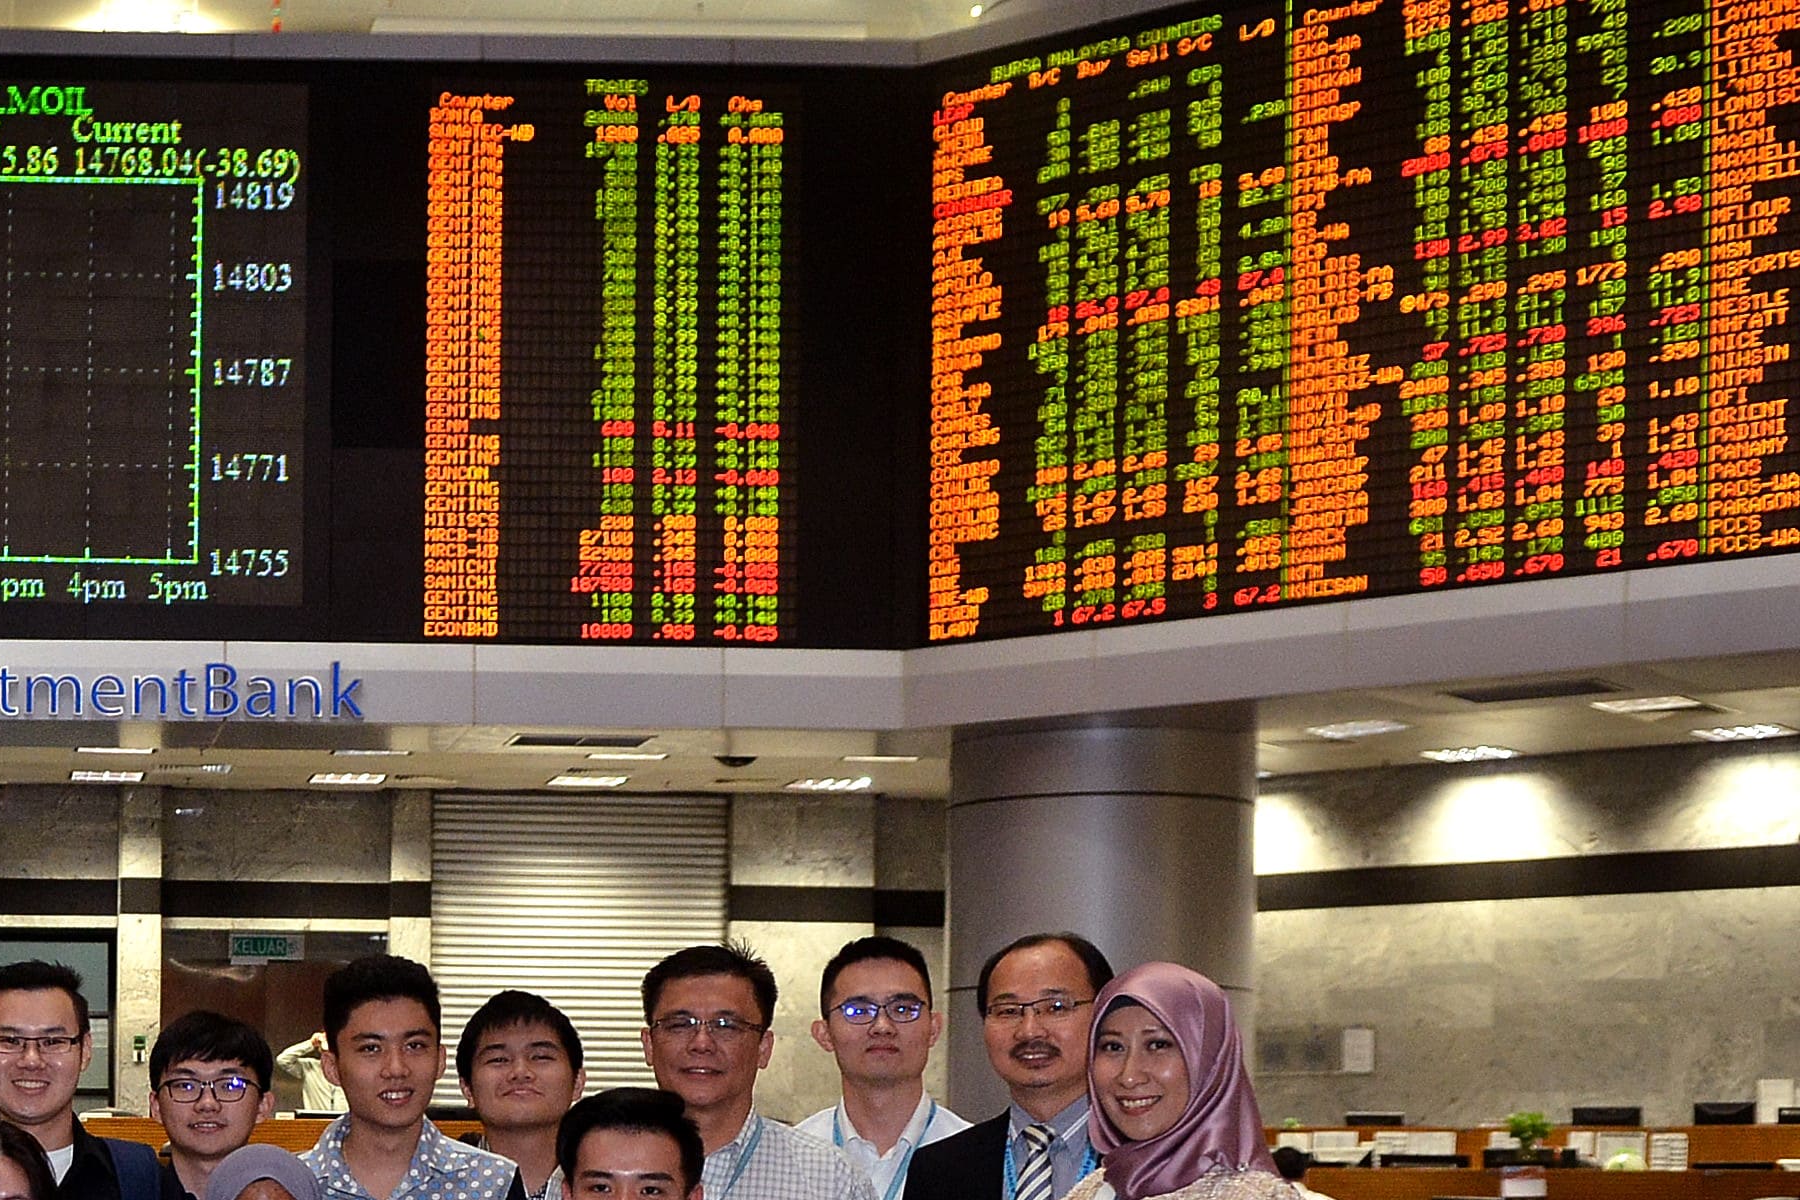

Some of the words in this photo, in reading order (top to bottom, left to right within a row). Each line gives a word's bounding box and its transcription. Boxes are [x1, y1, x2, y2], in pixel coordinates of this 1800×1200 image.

[1712, 35, 1779, 62] LEESK
[942, 81, 1012, 106] Counter
[73, 113, 183, 145] Current
[1712, 110, 1765, 135] LTKM
[1711, 125, 1776, 152] MAGNI
[214, 184, 295, 211] 14819
[1710, 197, 1791, 225] MFLOUR
[1710, 240, 1752, 260] MSM
[213, 264, 293, 291] 14803
[1710, 277, 1751, 298] MWE
[1709, 288, 1790, 316] NESTLE
[1709, 307, 1789, 334] NHFATT
[1709, 330, 1764, 352] NICE
[1709, 344, 1789, 370] NIHSIN
[212, 360, 292, 386] 14787
[1709, 366, 1764, 388] NTPM
[1708, 418, 1786, 443] PADINI
[211, 455, 290, 481] 14771
[425, 513, 499, 527] HIBISCS
[210, 550, 290, 576] 14755
[424, 560, 496, 573] SANICHI
[579, 562, 633, 576] 77200
[66, 574, 127, 603] 4pm
[147, 576, 209, 604] 5pm
[233, 938, 287, 955] KELUAR
